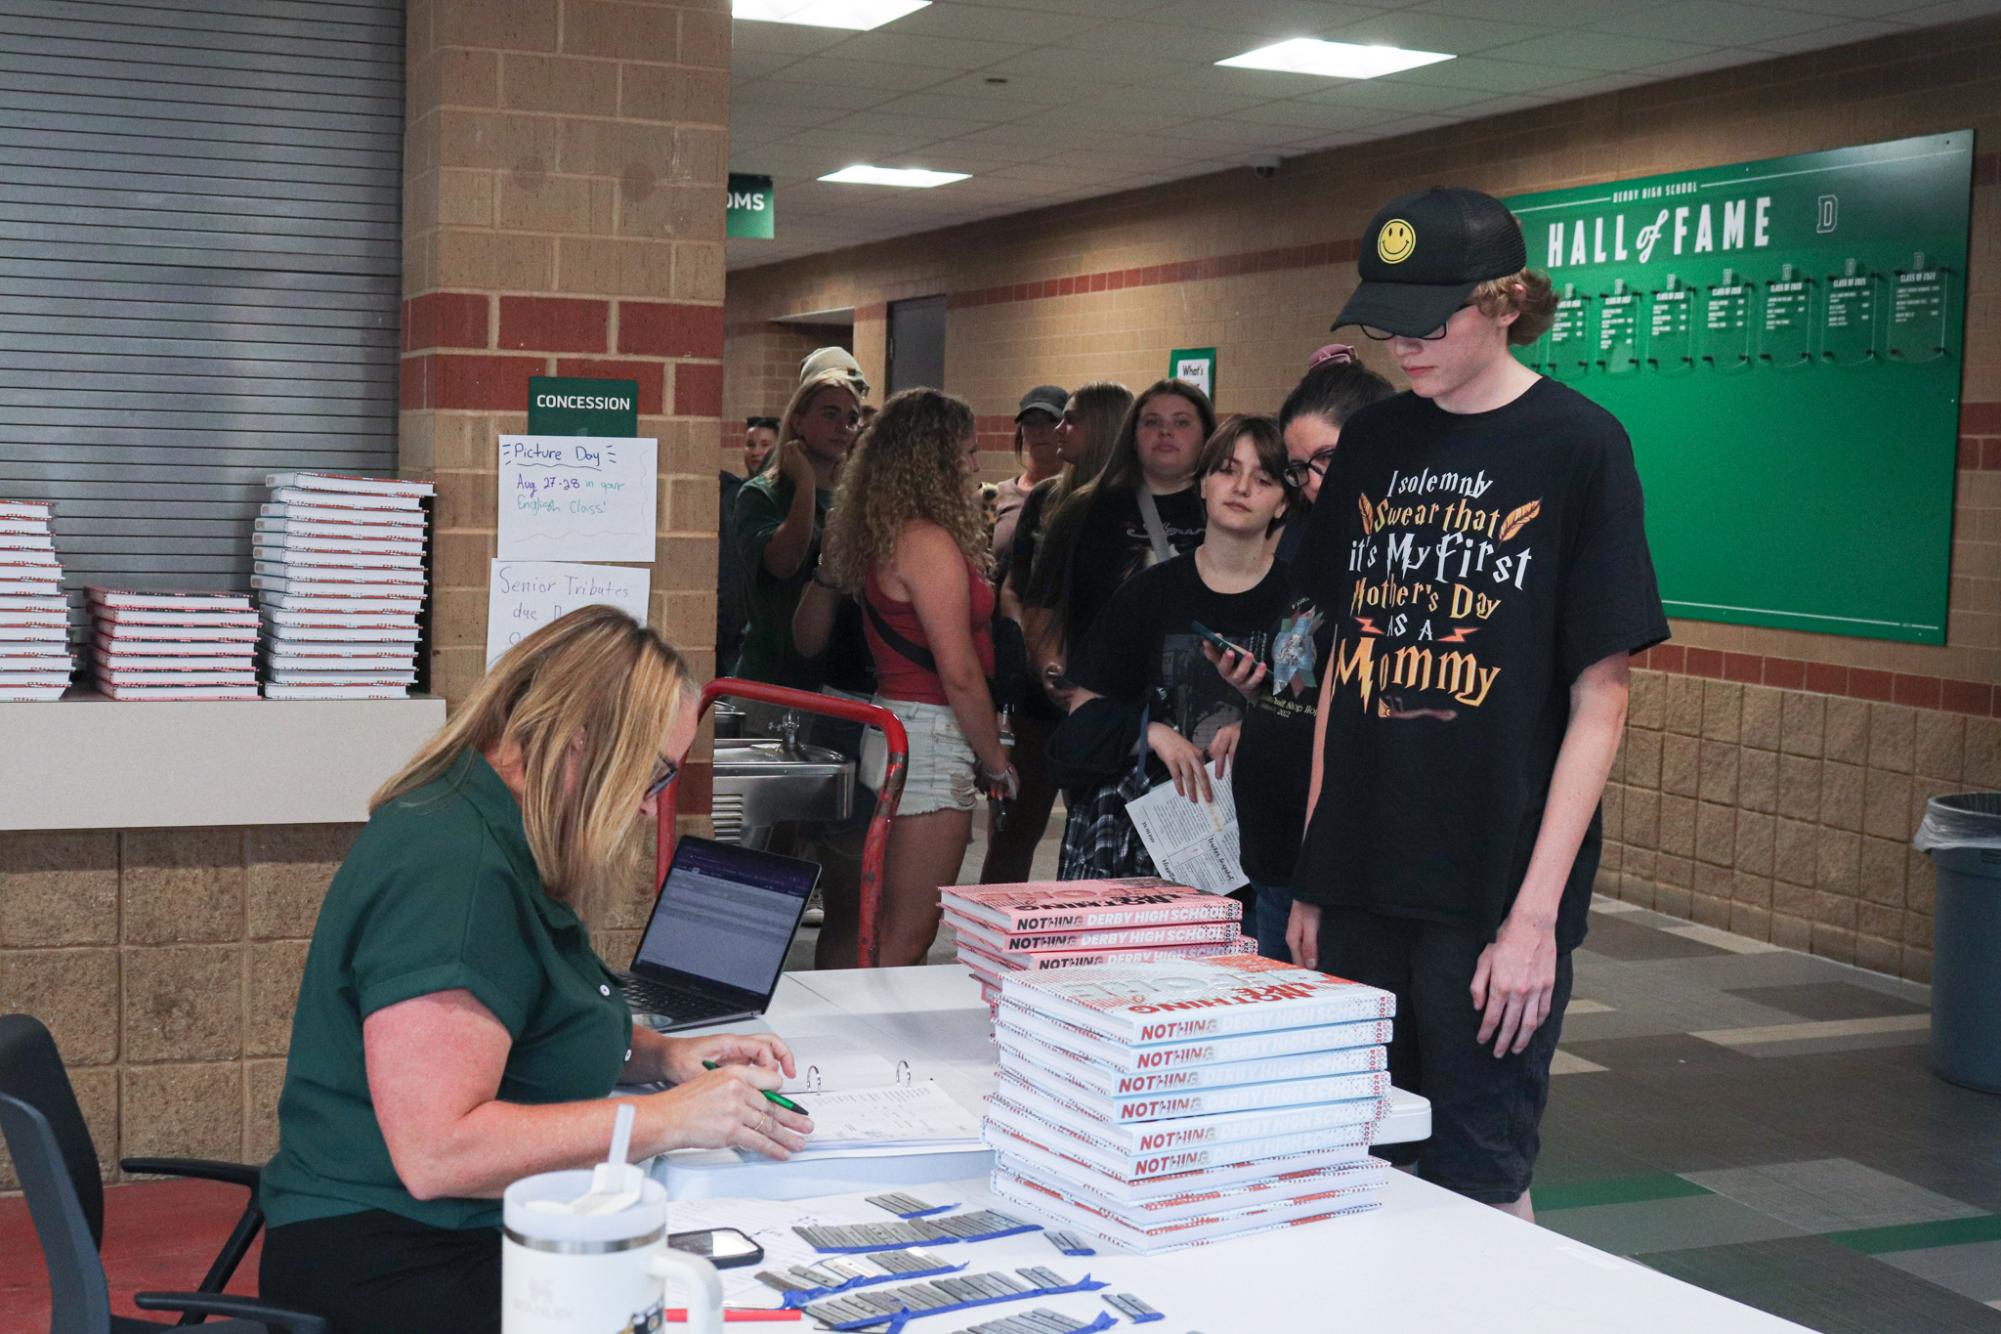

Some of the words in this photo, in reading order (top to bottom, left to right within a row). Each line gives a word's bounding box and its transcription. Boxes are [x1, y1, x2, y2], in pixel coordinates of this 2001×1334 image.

[1547, 214, 1628, 268] HALL
[1636, 208, 1670, 264] of
[1673, 196, 1771, 255] FAME
[537, 394, 630, 411] CONCESSION
[514, 442, 562, 461] Picture
[575, 446, 600, 466] Day
[517, 473, 537, 497] Aug
[585, 479, 594, 488] in
[1386, 470, 1399, 498] I
[1398, 467, 1494, 499] solemnly
[517, 494, 560, 516] English
[1374, 499, 1440, 534] Swear
[1442, 498, 1500, 539] that
[1348, 536, 1378, 572] it's
[1386, 532, 1432, 580] My
[1435, 531, 1533, 591] First
[499, 566, 556, 594] Senior
[565, 574, 629, 598] Tributes
[1350, 573, 1440, 617] Mother's
[1449, 583, 1502, 620] Day
[1417, 619, 1434, 641] A
[1331, 636, 1502, 715] Mommy
[1014, 896, 1174, 911] NOTHING
[1016, 915, 1084, 931] NOTHING
[1087, 912, 1134, 926] DERBY
[1135, 909, 1170, 923] HIGH
[1171, 907, 1227, 921] SCHOOL
[1008, 935, 1077, 950] NOTHING
[1081, 931, 1127, 945] DERBY
[1129, 929, 1166, 943] HIGH
[1167, 926, 1223, 941] SCHOOL
[1127, 987, 1315, 1014] NOTHING
[1140, 1018, 1218, 1041] NOTHING
[1137, 1046, 1215, 1069] NOTHING
[1118, 1071, 1199, 1094] NOTHING
[1121, 1097, 1203, 1119] NOTHING
[1140, 1127, 1217, 1151] NOTHING
[1135, 1150, 1210, 1176] NOTHING
